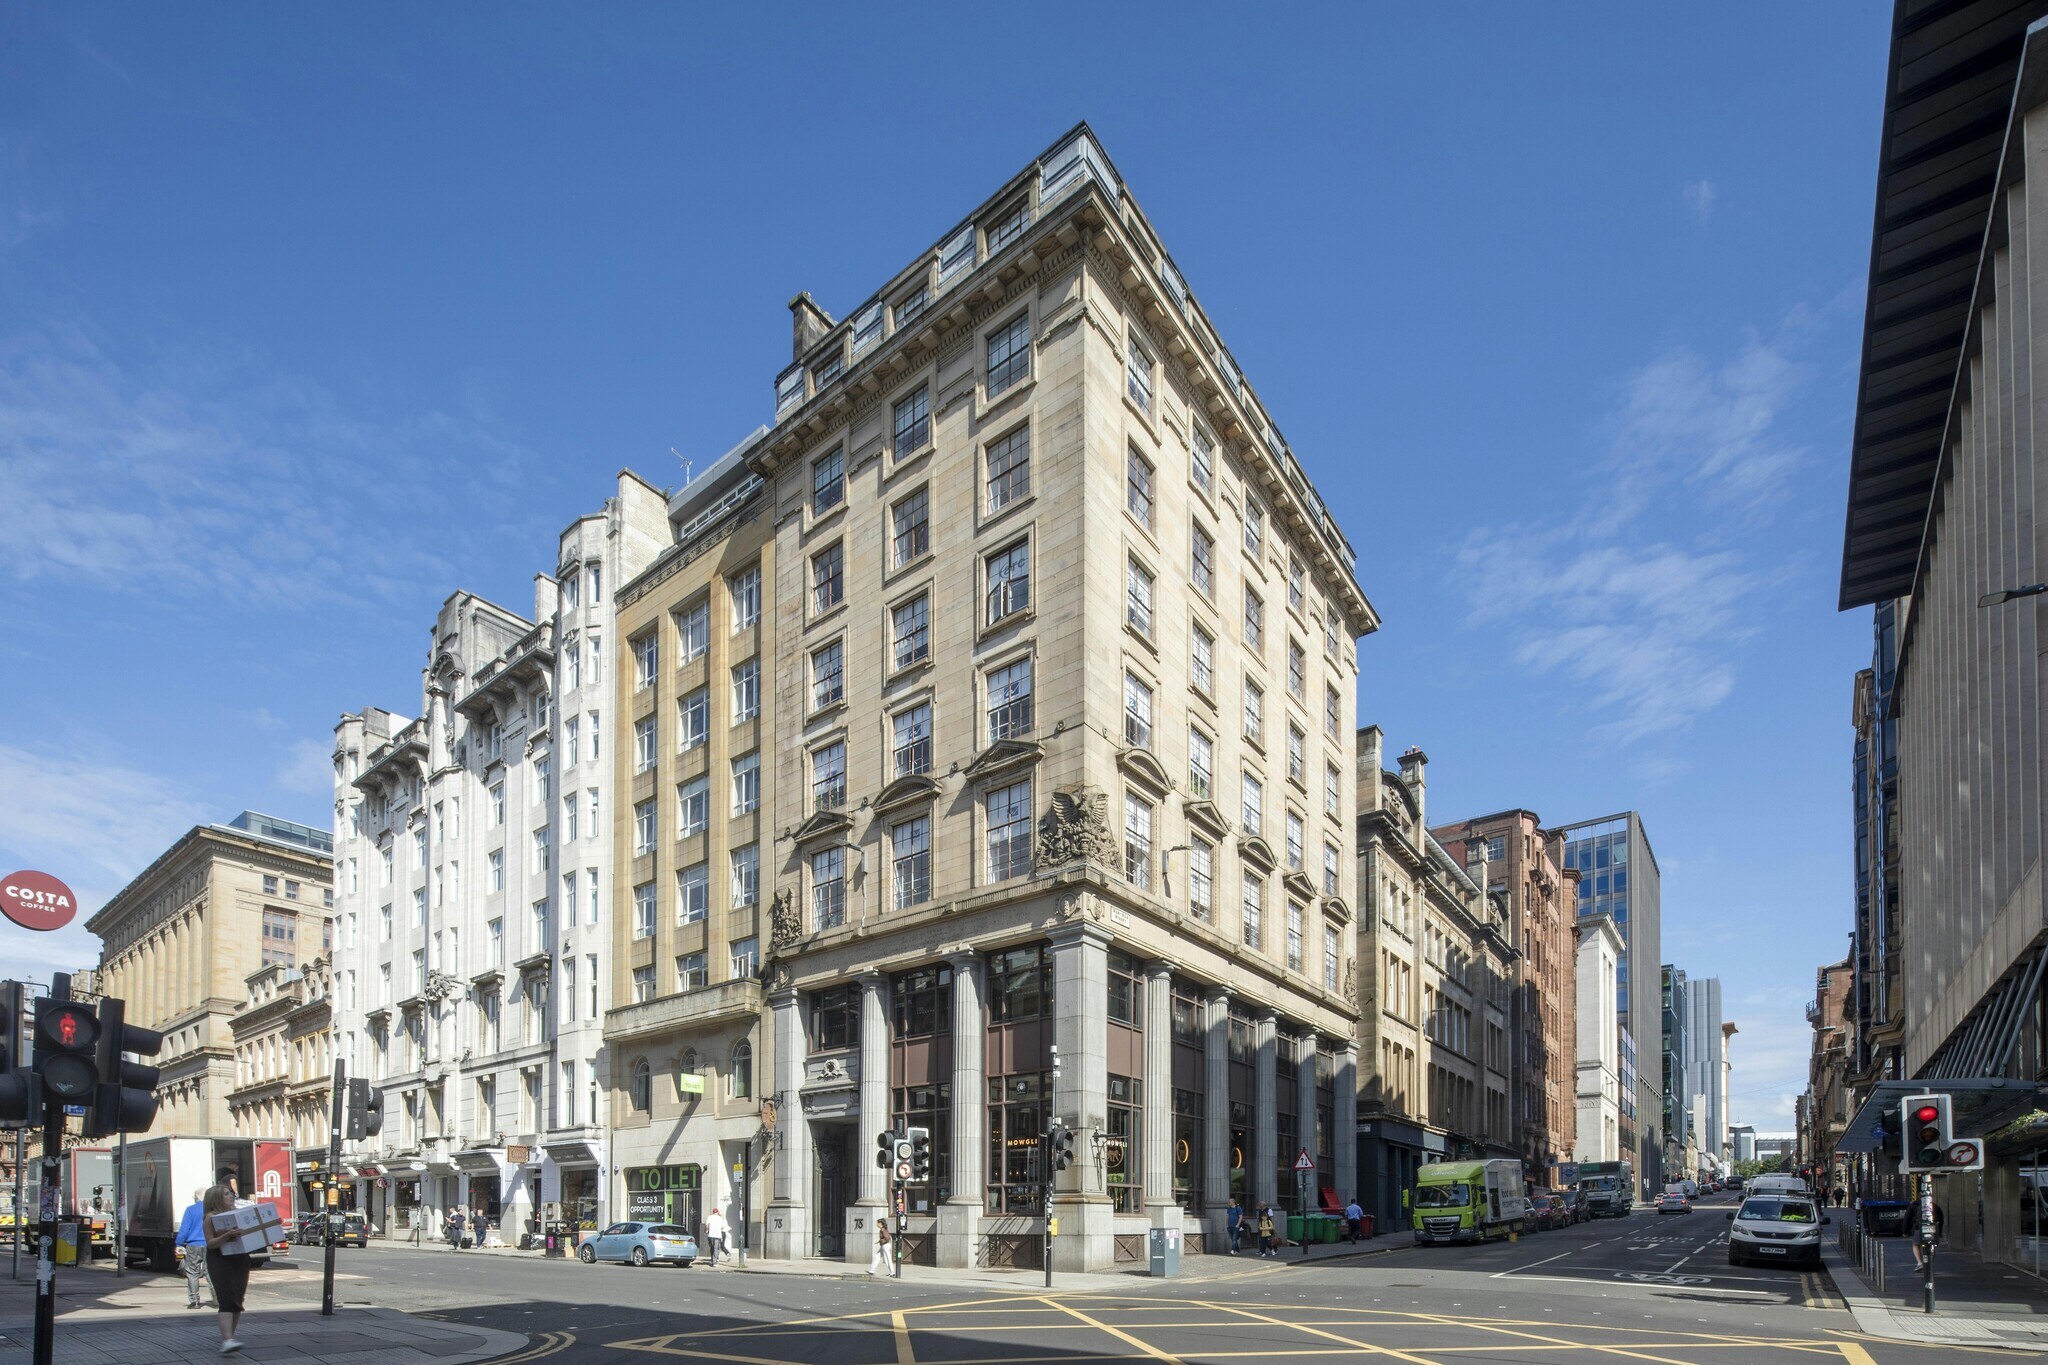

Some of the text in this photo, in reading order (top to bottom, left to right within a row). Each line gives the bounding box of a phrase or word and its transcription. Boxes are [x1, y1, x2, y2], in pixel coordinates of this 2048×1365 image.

[5, 885, 70, 908] COSTA
[20, 901, 56, 912] COFFEE
[1007, 1138, 1038, 1146] MOWGLI
[640, 1166, 699, 1190] TO LET
[637, 1196, 658, 1204] CLASS 3
[630, 1205, 664, 1213] OPPORTUNITY
